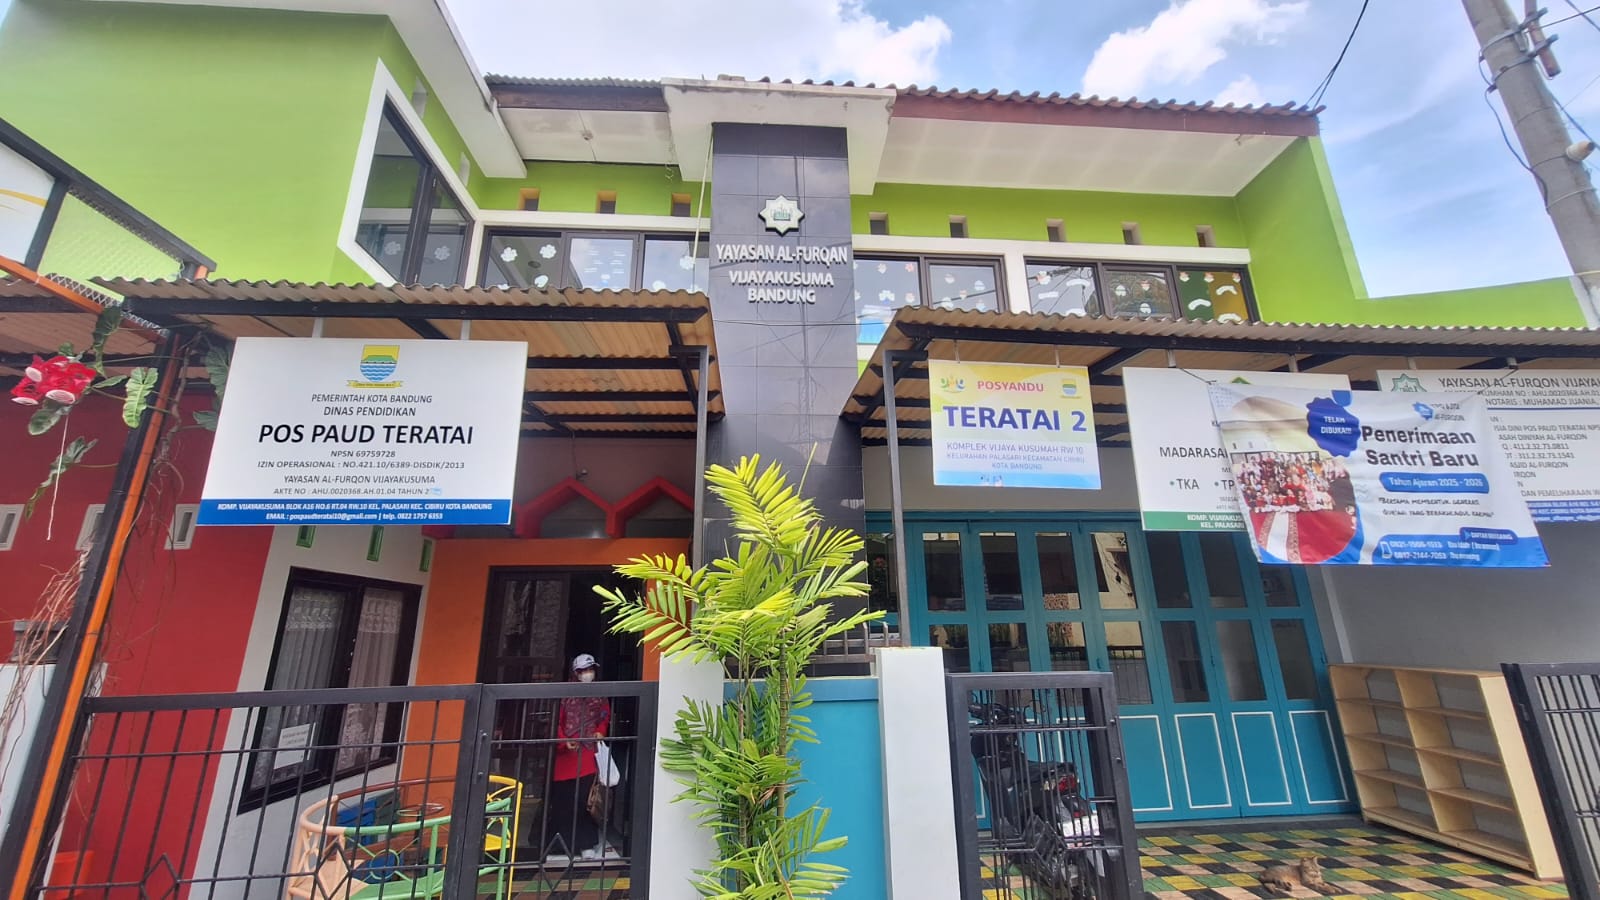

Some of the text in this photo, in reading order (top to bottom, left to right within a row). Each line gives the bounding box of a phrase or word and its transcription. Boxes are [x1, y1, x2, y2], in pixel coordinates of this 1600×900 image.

[716, 244, 847, 266] YAYASAN AL-FURQAN
[729, 271, 834, 286] VIJAYAKUSUMA
[748, 288, 816, 303] BANDUNG
[977, 380, 1044, 392] POSYANDU
[1439, 378, 1489, 388] YAYASAN
[1494, 378, 1560, 388] AL-FURQON
[311, 394, 433, 404] PEMERINTAH KOTA BANDUNG
[323, 406, 416, 417] DINAS PENDIDIKAN
[943, 406, 1087, 432] TERATAI 2
[259, 424, 473, 444] POS PAUD TERATAI
[1362, 426, 1475, 444] Penerimaan
[947, 442, 1084, 455] KOMPLEK VIJAYA KUSUMAH RW 10
[1366, 450, 1479, 467] Santri Baru
[284, 475, 320, 483] YAYASAN
[322, 475, 370, 484] AL-FURQON
[1176, 479, 1199, 489] TKA
[1389, 477, 1412, 486] Tahun
[1413, 478, 1438, 488] Ajaran
[1439, 478, 1459, 487] 2025
[1464, 479, 1483, 487] 2026
